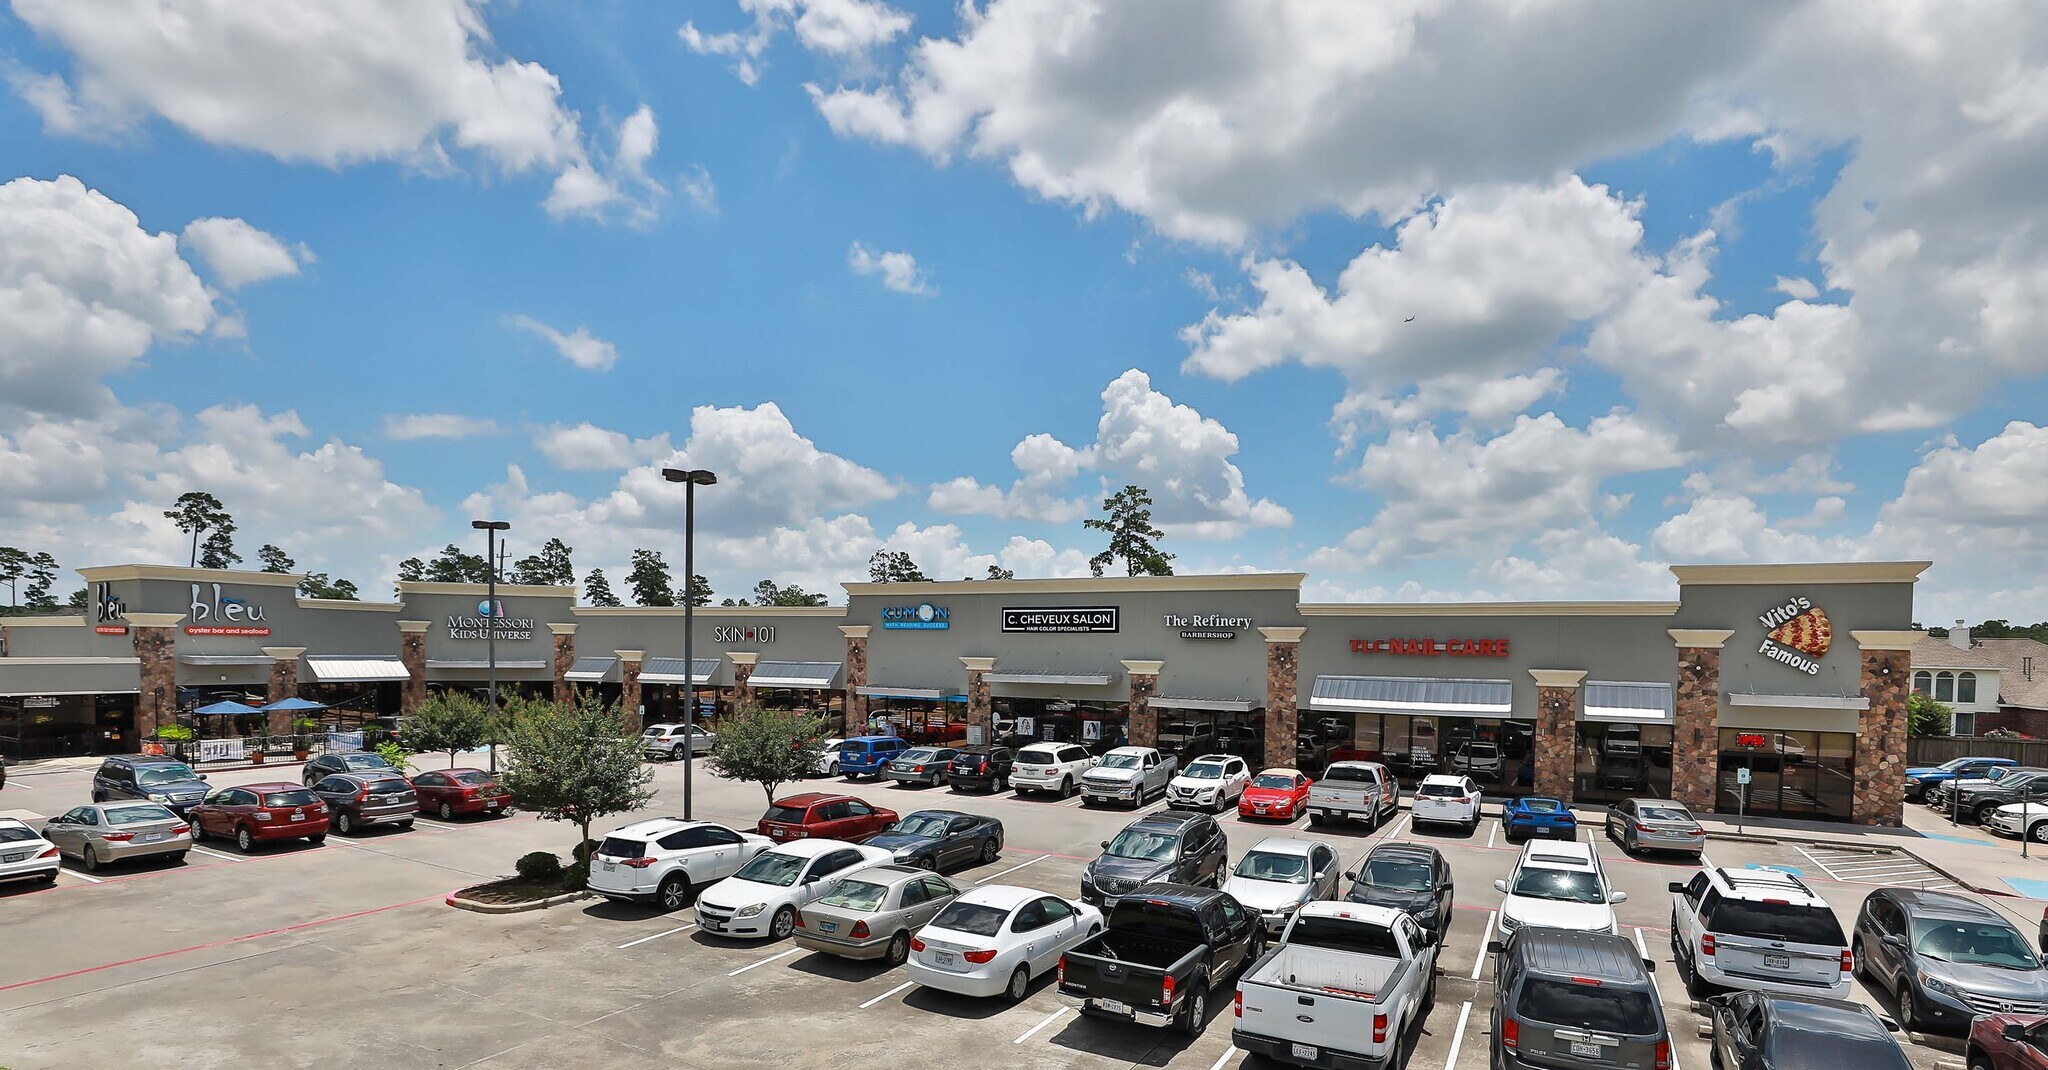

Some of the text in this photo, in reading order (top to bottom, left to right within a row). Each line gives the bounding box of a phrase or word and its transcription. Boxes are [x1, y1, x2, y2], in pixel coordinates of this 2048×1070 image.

[882, 604, 948, 622] KUMON
[1008, 614, 1110, 624] C. CHEVEUX SALON
[1759, 597, 1811, 628] Vito's
[1164, 614, 1252, 630] The Refinery
[450, 629, 476, 639] KIDS
[715, 626, 774, 642] SKIN 101
[1350, 639, 1510, 657] TLC NAIL CARE
[1759, 640, 1819, 675] Famous
[1530, 1048, 1547, 1056] PILOT
